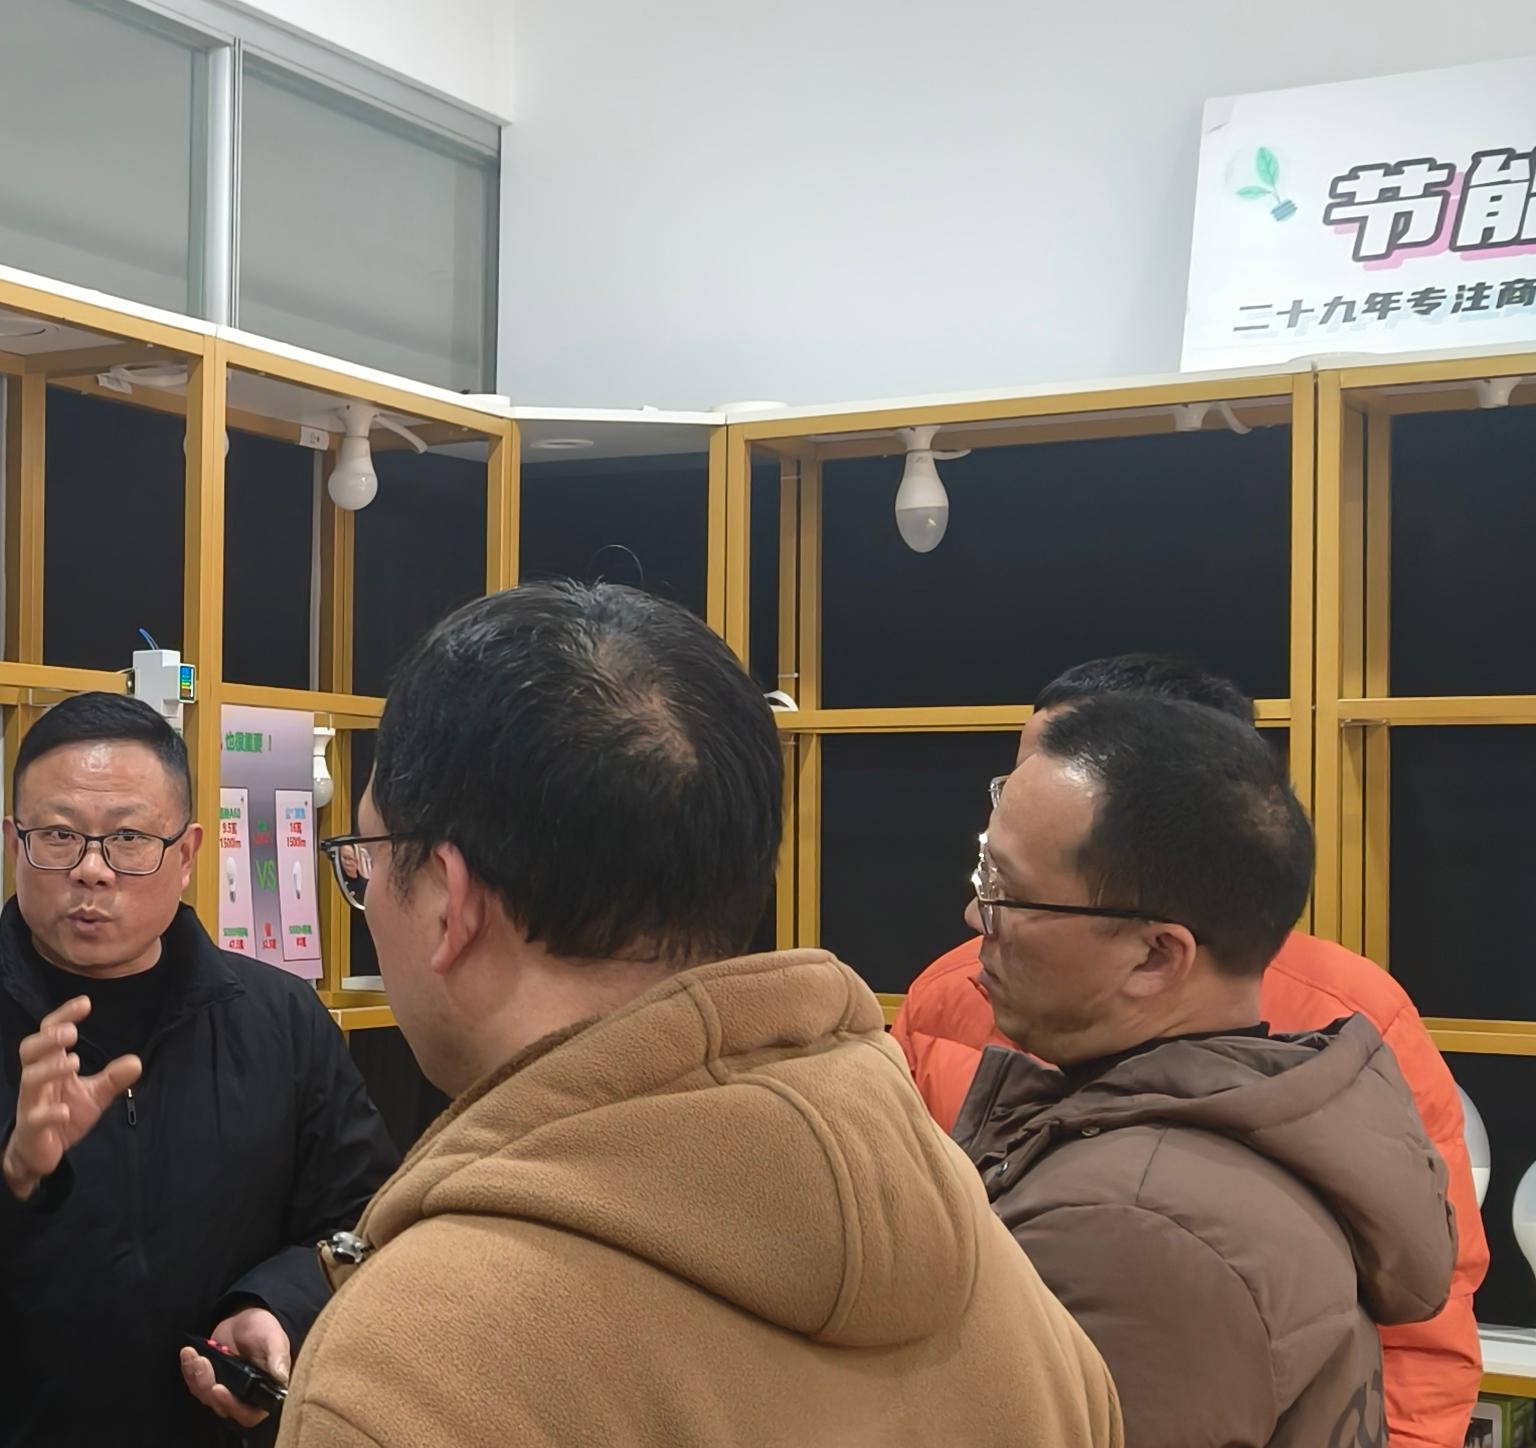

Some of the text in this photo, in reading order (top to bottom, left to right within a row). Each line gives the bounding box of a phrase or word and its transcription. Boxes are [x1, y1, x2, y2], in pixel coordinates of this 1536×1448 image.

[1233, 277, 1536, 332] 二十九年专注商
[255, 859, 277, 891] VS
